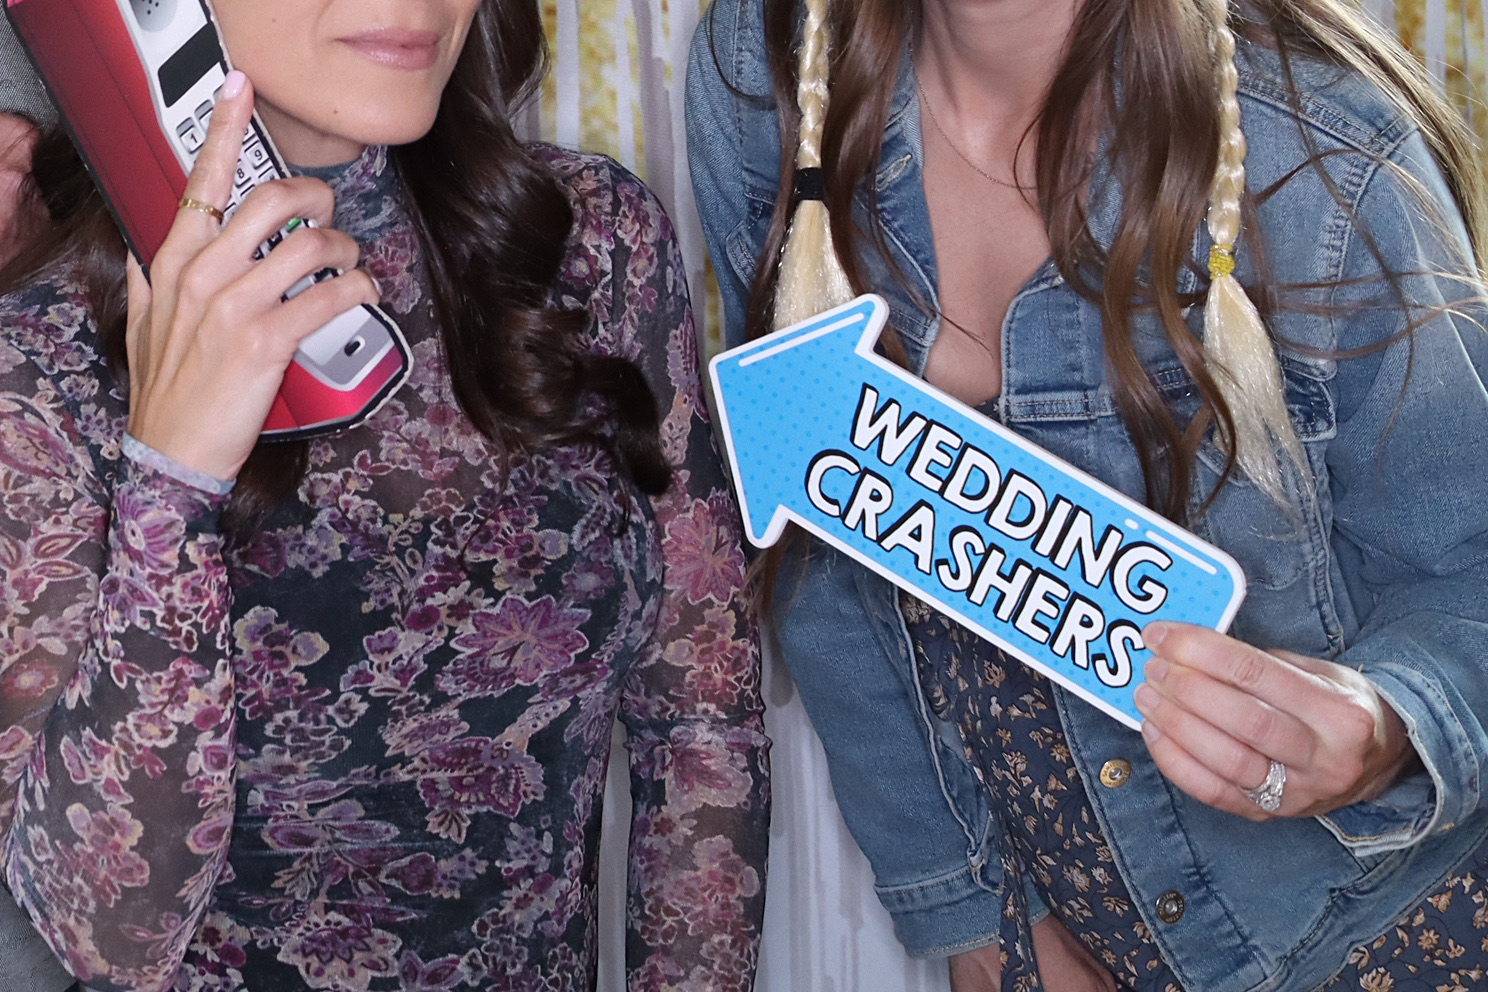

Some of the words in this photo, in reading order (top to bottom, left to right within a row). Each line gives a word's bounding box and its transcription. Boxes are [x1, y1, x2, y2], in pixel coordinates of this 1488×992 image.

[190, 133, 198, 144] 1
[254, 149, 263, 161] 9
[236, 168, 245, 179] 8
[849, 383, 1172, 614] WEDDING
[805, 449, 1146, 688] CRASHERS
